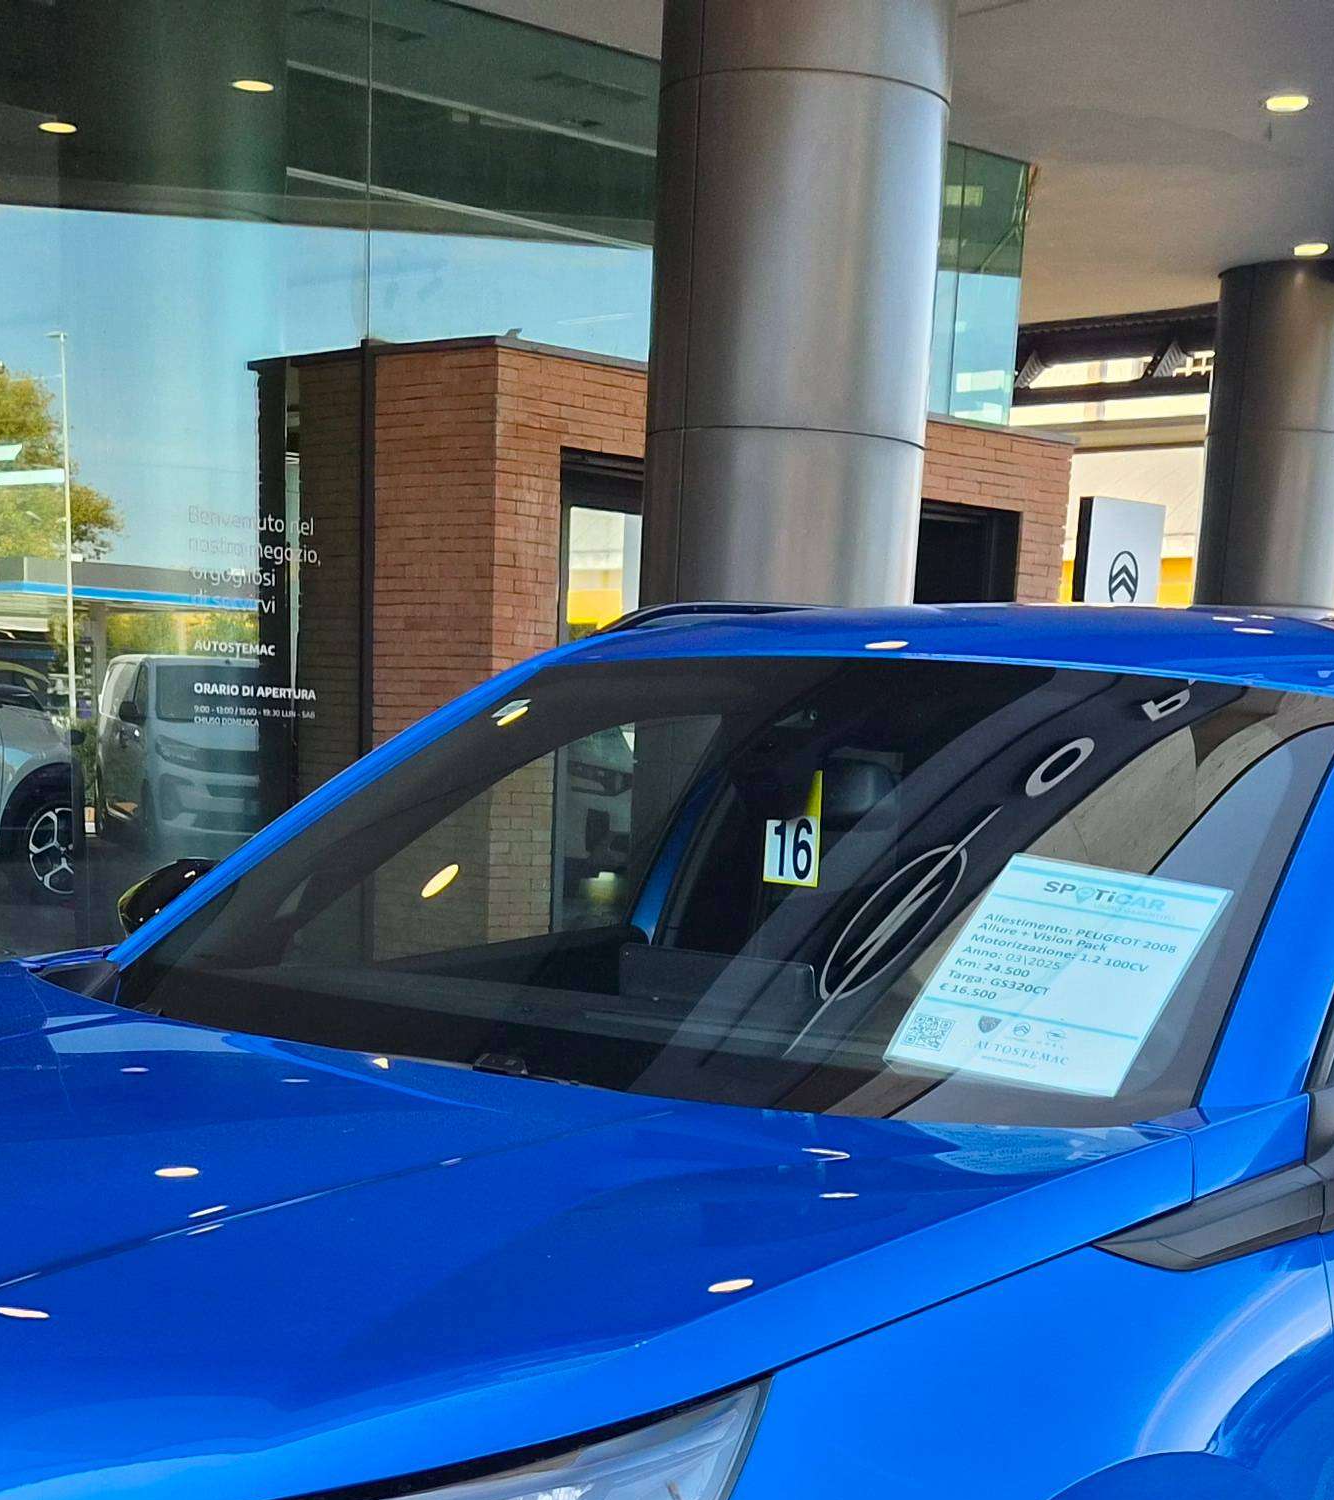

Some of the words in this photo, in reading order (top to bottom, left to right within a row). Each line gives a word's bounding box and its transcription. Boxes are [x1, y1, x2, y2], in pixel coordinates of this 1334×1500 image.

[291, 517, 314, 536] nel
[194, 639, 276, 656] AUTOSTEMAC
[194, 682, 239, 697] ORARIO
[242, 685, 254, 697] DI
[256, 687, 316, 701] APERTURA
[774, 818, 812, 880] 16
[978, 922, 1017, 936] Allure
[1033, 931, 1073, 946] Vision
[1076, 939, 1108, 952] Pack
[985, 913, 1073, 936] Allestimento:
[1075, 928, 1141, 947] PEUGEOT
[1142, 942, 1178, 954] 2008
[962, 945, 1003, 960] Anno:
[970, 934, 1077, 960] Motorizzazione:
[1080, 953, 1101, 964] 1.2
[1105, 957, 1149, 973] 100CV
[955, 957, 980, 969] Km:
[983, 962, 1030, 978] 24.500
[948, 969, 987, 985] Targa:
[990, 977, 1051, 996] GS320CT
[951, 984, 997, 1000] 16.500
